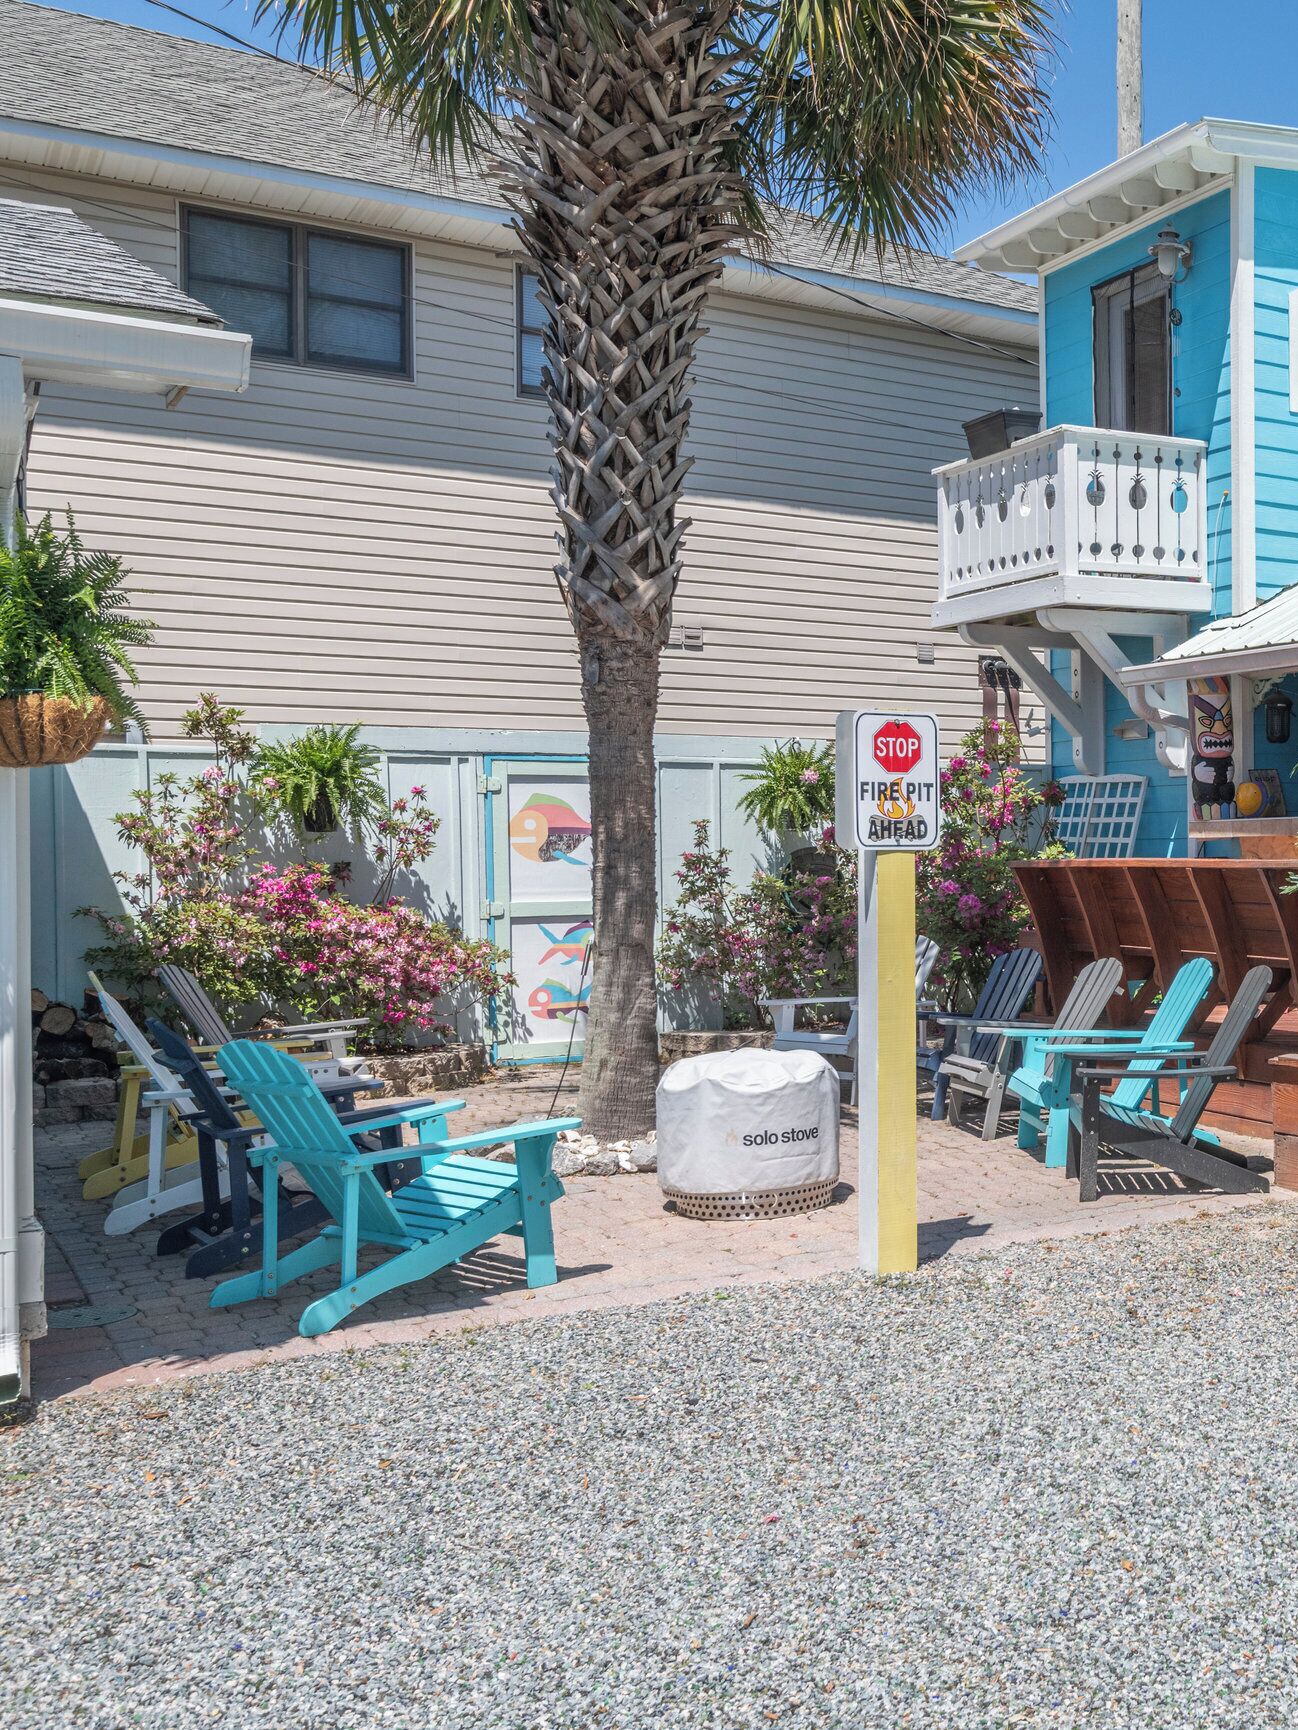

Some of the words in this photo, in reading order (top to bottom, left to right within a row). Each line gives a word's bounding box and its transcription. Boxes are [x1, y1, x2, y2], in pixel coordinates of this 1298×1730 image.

[876, 737, 919, 758] STOP
[860, 781, 900, 801] FIRE
[906, 782, 934, 802] PIT
[867, 819, 928, 840] AHEAD
[743, 1130, 779, 1147] solo
[781, 1126, 819, 1144] stove
